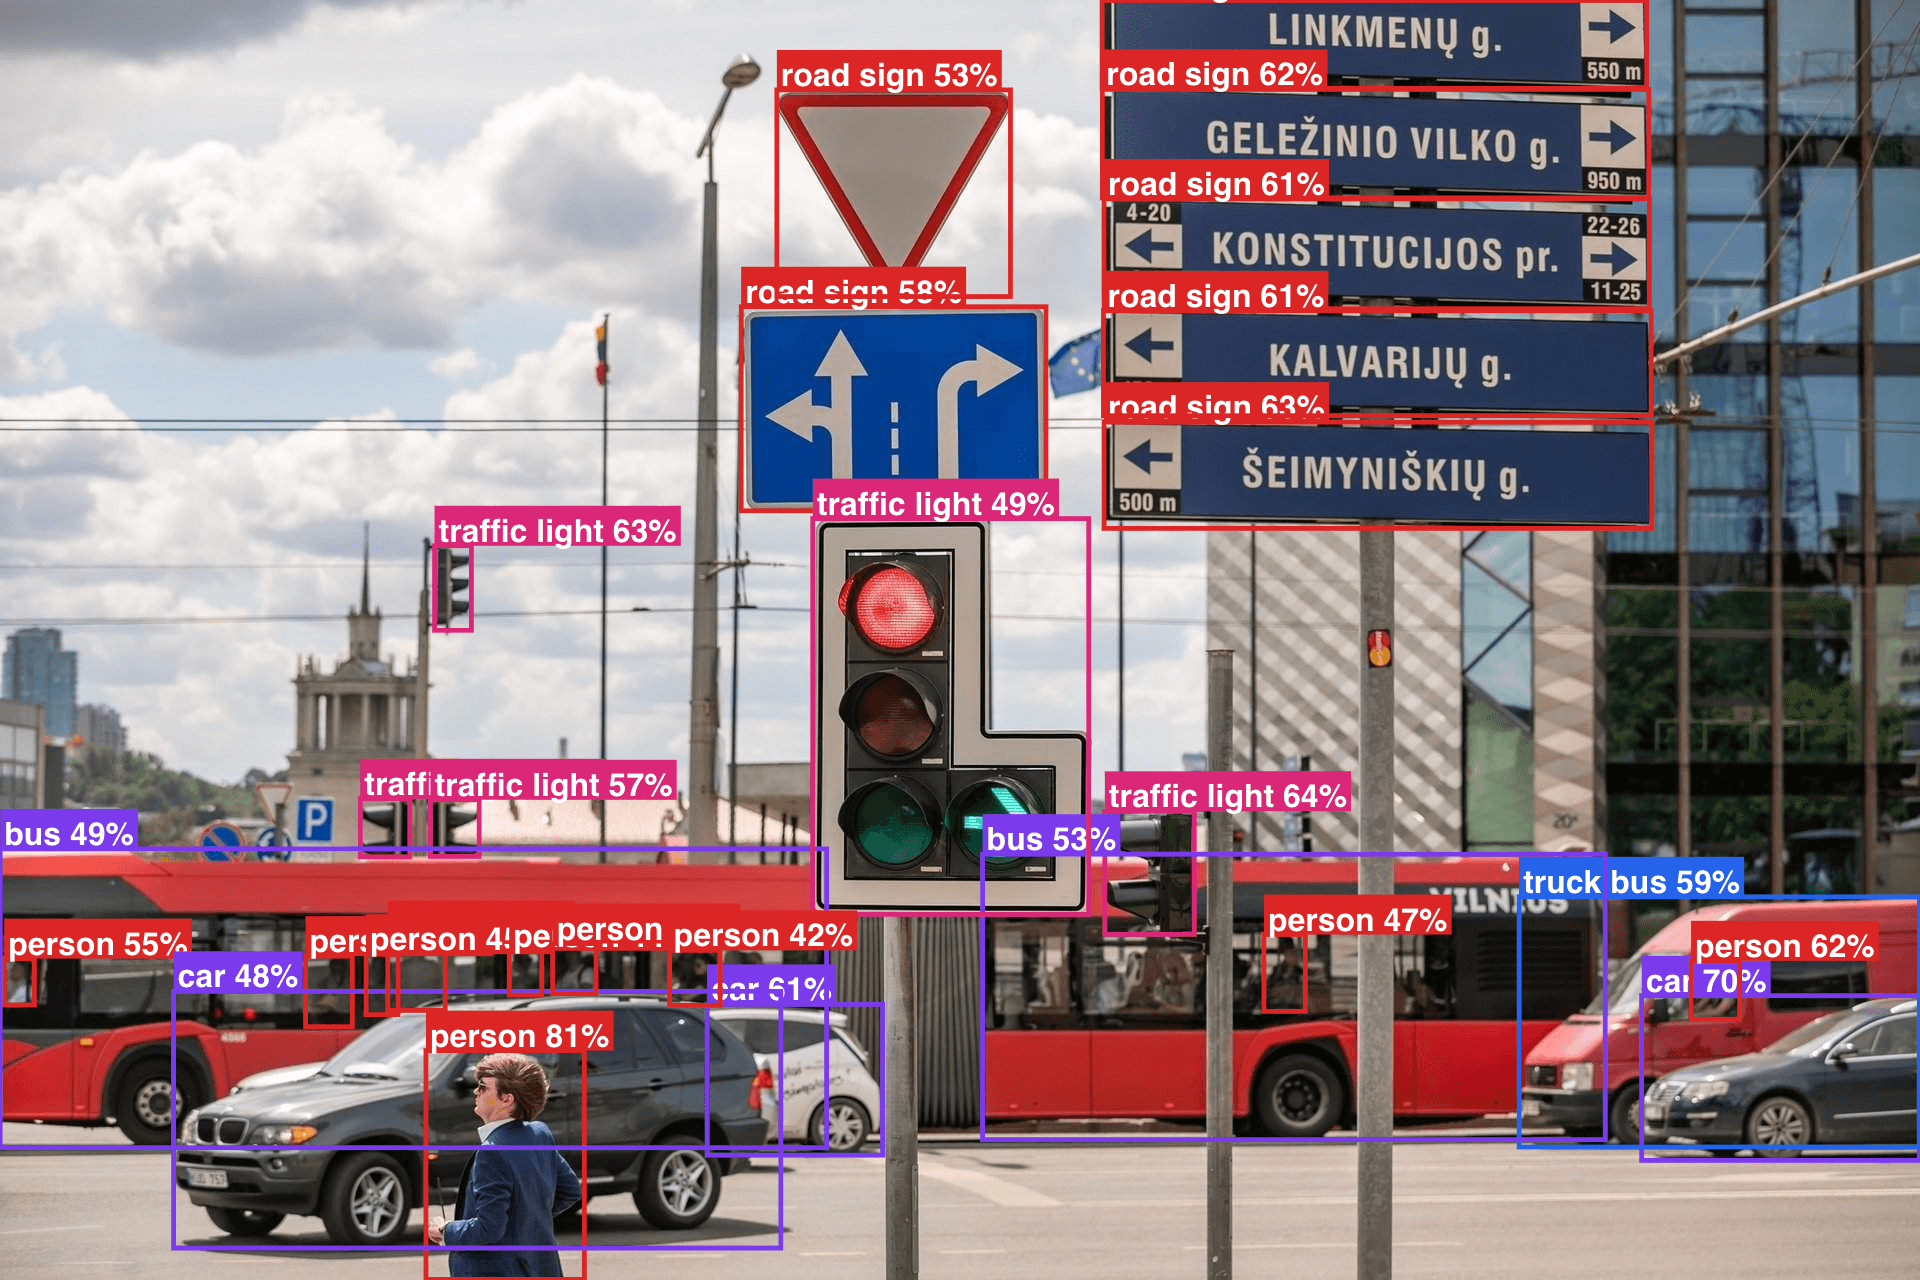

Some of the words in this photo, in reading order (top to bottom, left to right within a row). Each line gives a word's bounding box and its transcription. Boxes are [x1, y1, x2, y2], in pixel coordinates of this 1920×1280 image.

[1270, 13, 1457, 58] LINKMENŲ
[1472, 27, 1501, 58] g.
[1588, 62, 1619, 79] 550
[1626, 67, 1640, 80] m
[1207, 116, 1396, 158] GELEŽINIO
[1411, 128, 1515, 162] VILKO
[1530, 138, 1559, 170] g.
[1588, 172, 1619, 189] 950
[1627, 177, 1641, 190] m
[1126, 204, 1171, 222] 4-20
[1588, 217, 1639, 235] 22-26
[1214, 232, 1501, 271] KONSTITUCIJOS
[1517, 247, 1557, 278] pr.
[1590, 283, 1641, 302] 11-25
[1271, 344, 1466, 388] KALVARIJŲ
[1482, 355, 1510, 387] g.
[1243, 448, 1484, 500] ŠEIMYNIŠKIŲ
[1500, 468, 1528, 499] g.
[1120, 493, 1153, 511] 500
[1160, 498, 1175, 511] m
[1429, 887, 1569, 914] ILNIUS
